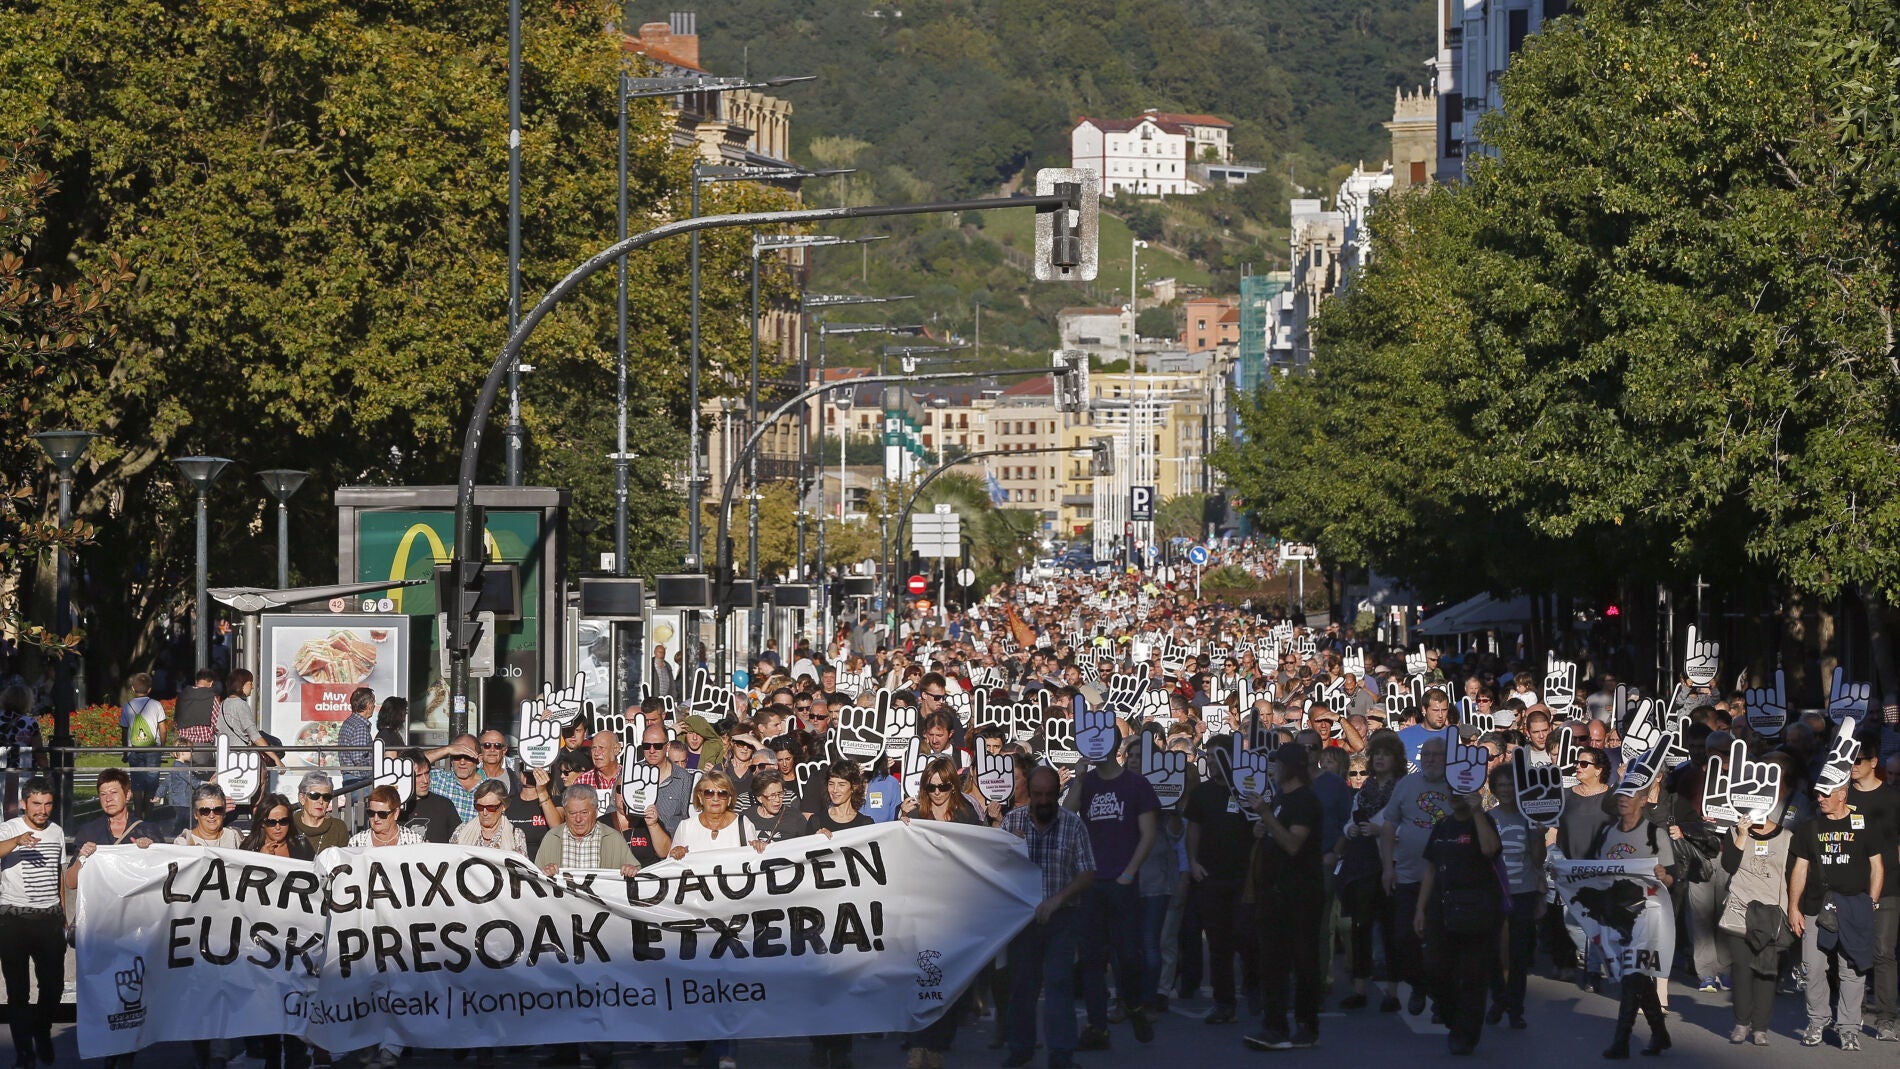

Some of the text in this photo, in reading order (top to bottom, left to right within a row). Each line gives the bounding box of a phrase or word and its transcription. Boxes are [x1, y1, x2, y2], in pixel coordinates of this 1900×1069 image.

[322, 691, 347, 704] Muy
[1092, 791, 1117, 805] GORA
[1817, 830, 1855, 842] uskaraz
[1824, 842, 1842, 854] bizi
[626, 841, 887, 907] DAUDEN
[1571, 865, 1625, 874] PRESO ETA
[168, 900, 886, 979] EUSK PRESOAK ETXERA!
[462, 981, 657, 1018] Konponbidea
[682, 978, 767, 1004] Bakea
[918, 991, 943, 1001] SARE
